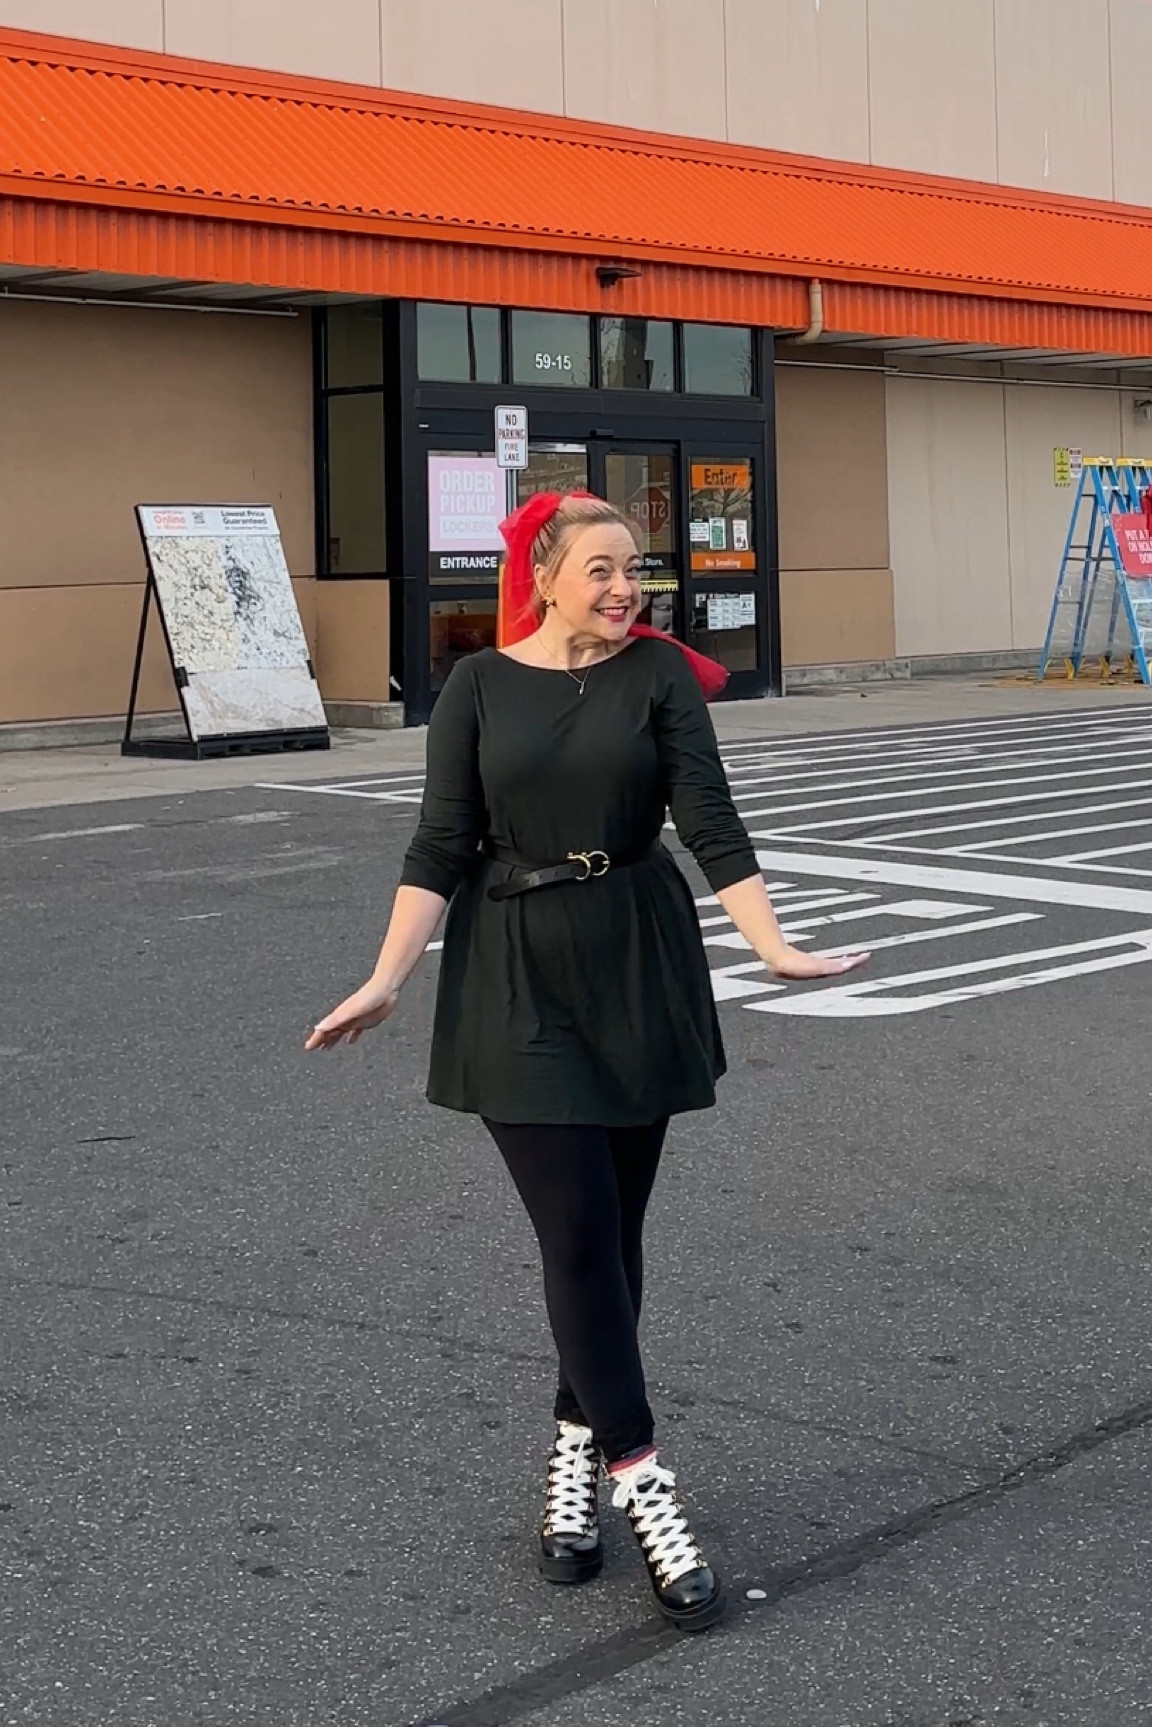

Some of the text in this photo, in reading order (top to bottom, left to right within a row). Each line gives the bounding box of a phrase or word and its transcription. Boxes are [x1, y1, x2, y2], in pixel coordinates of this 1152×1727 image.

[535, 353, 571, 370] 59-15
[505, 414, 517, 426] NO
[505, 453, 519, 461] LANE
[440, 470, 495, 492] ORDER
[704, 468, 737, 485] Enter
[440, 494, 496, 513] PICKUP
[154, 515, 186, 523] Online
[443, 520, 495, 533] LOCKERS
[440, 557, 498, 569] ENTRANCE
[705, 559, 741, 568] No Smoking
